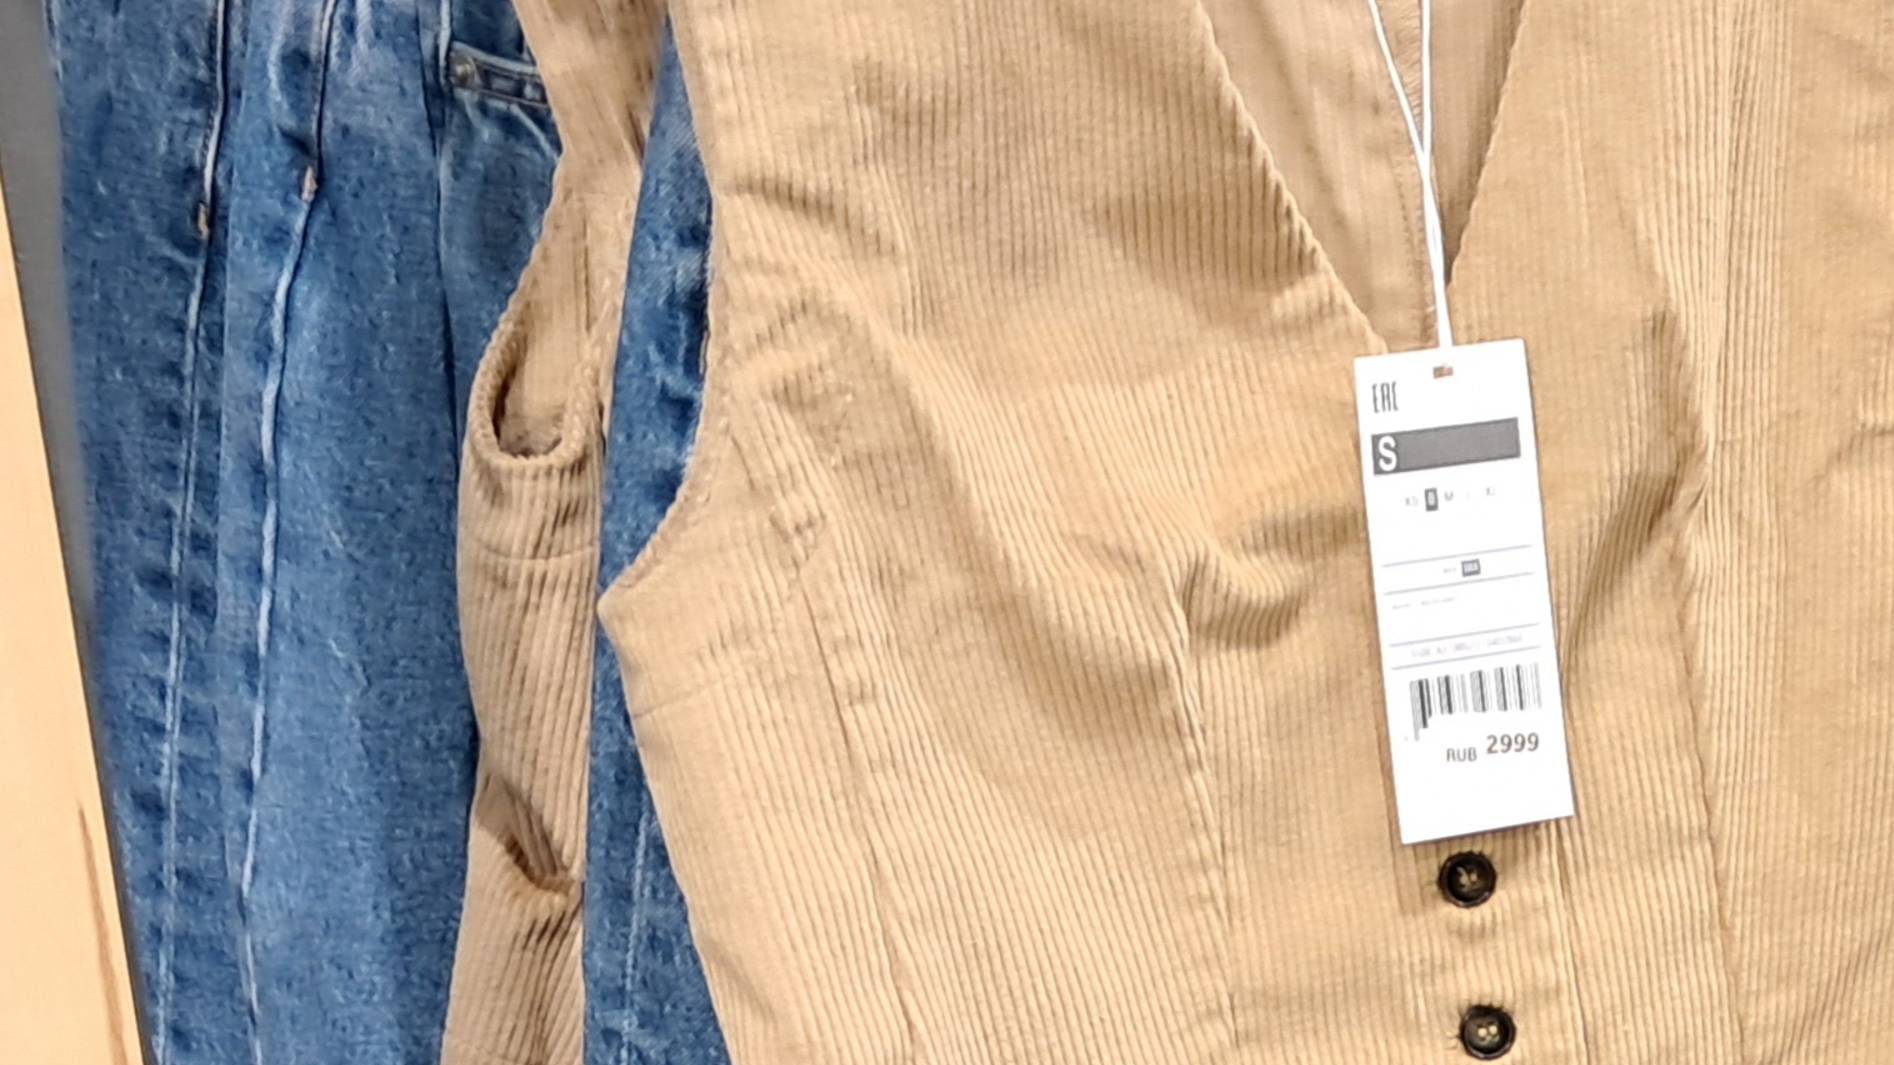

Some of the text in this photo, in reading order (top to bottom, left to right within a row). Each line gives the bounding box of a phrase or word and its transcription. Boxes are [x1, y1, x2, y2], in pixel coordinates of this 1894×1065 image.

[1379, 435, 1397, 471] S
[1446, 732, 1540, 762] RUB 2999
